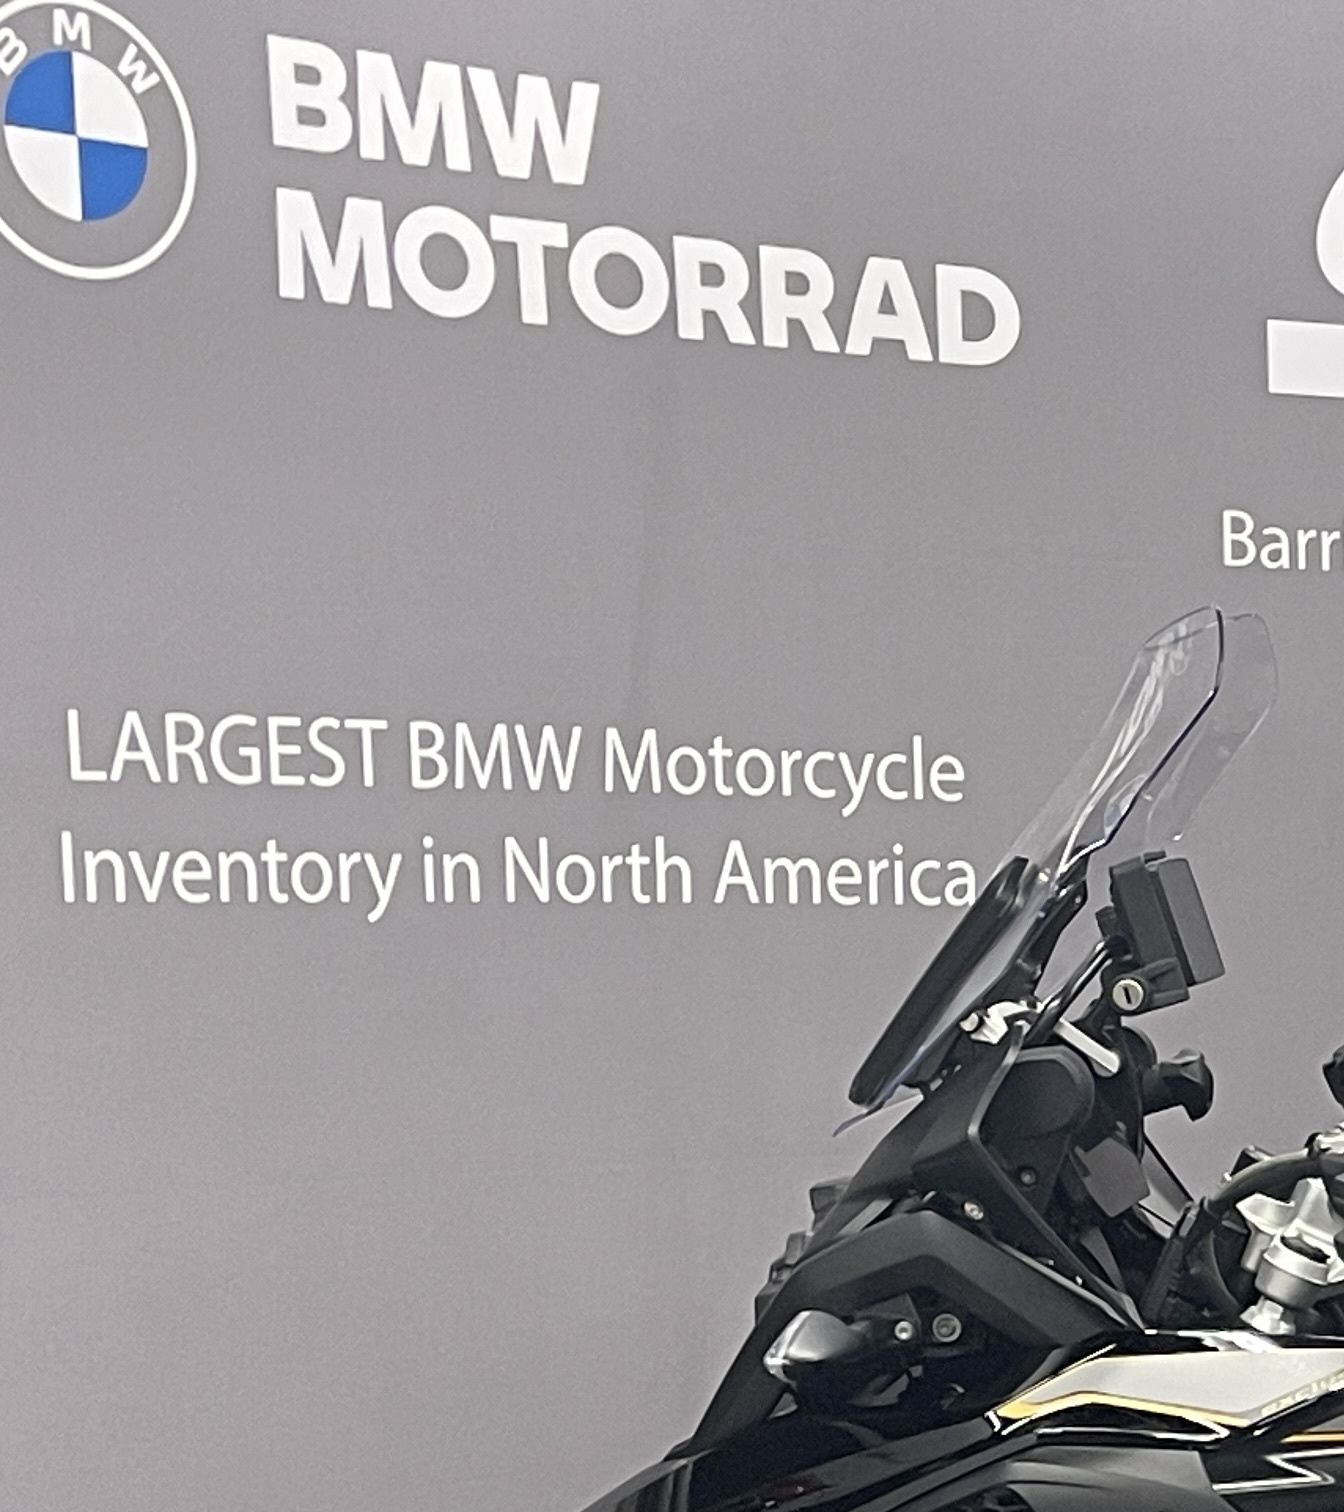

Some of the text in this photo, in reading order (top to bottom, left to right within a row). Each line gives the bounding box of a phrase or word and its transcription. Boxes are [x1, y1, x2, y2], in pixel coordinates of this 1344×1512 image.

[266, 33, 600, 186] BMW
[276, 187, 1021, 367] MOTORRAD
[66, 708, 966, 818] LARGEST BMW Motorcycle
[60, 830, 977, 922] Inventory in North America
